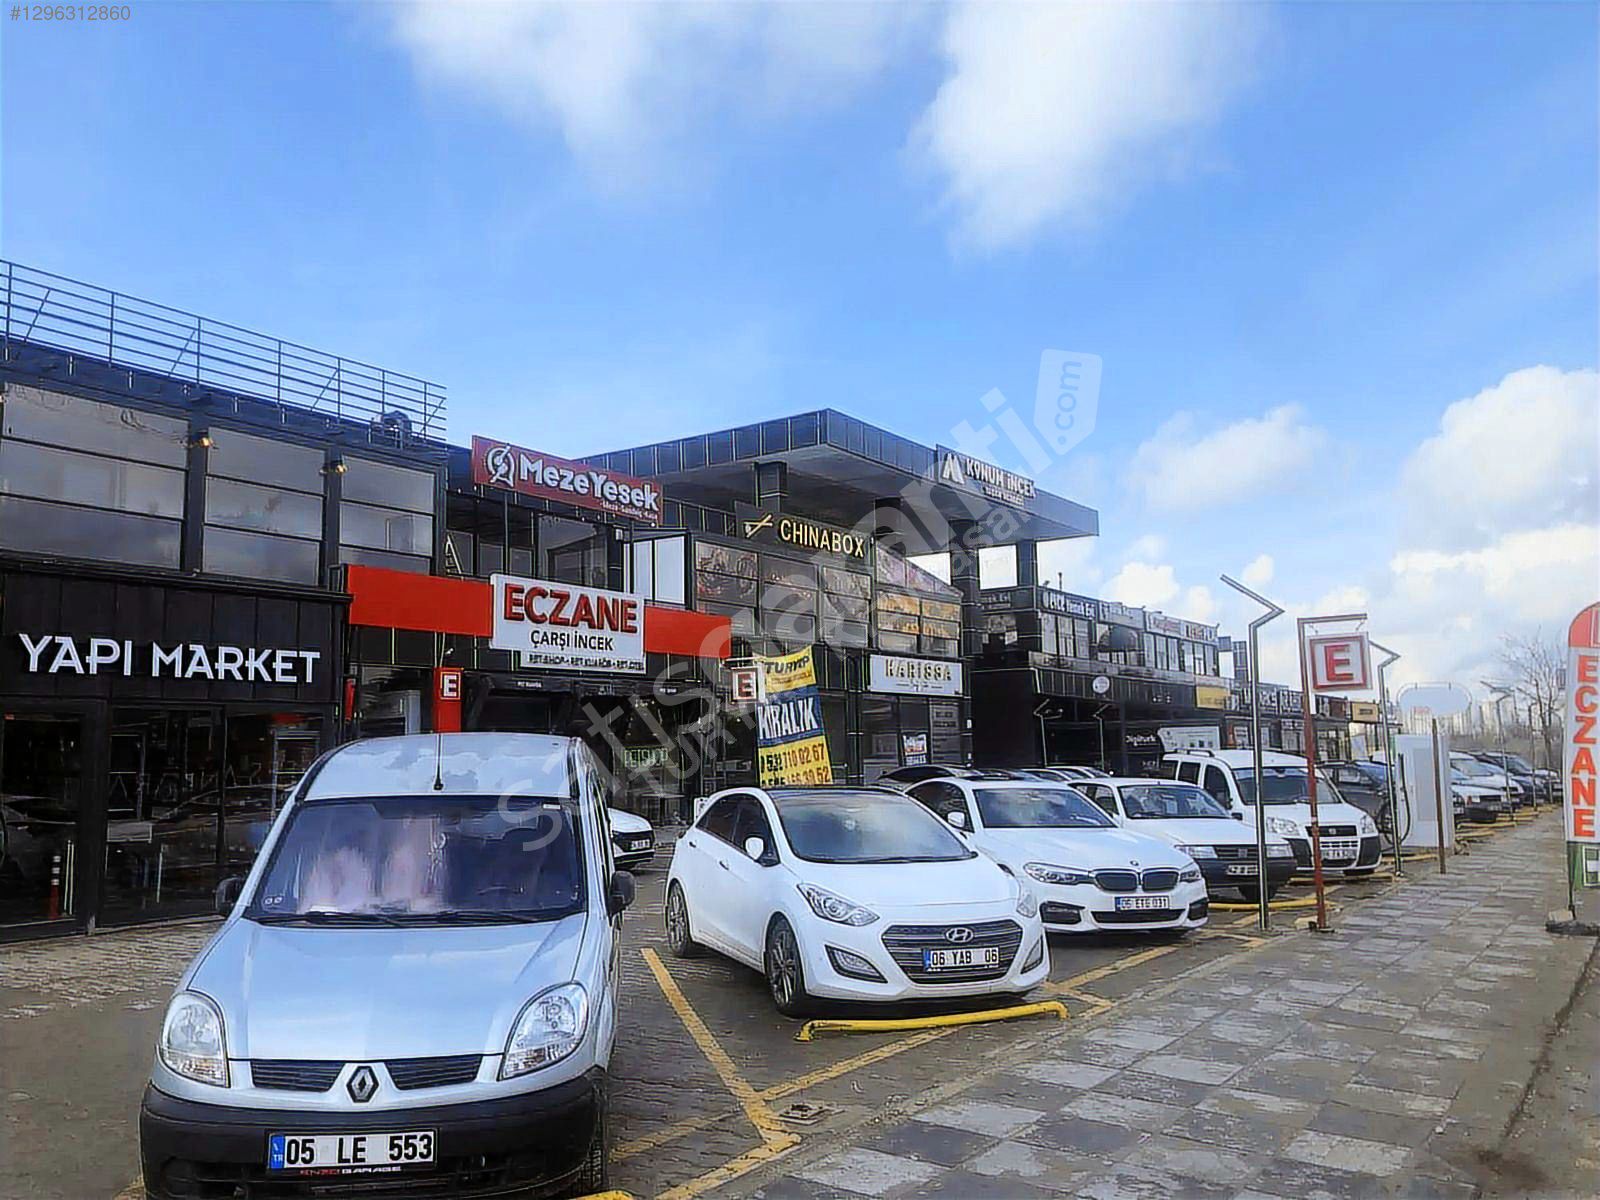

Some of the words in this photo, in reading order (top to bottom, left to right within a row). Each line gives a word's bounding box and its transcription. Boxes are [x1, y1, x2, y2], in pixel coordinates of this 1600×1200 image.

[520, 453, 659, 511] MezeYesek
[780, 519, 864, 558] CHINABOX
[504, 583, 638, 633] ECZANE
[19, 633, 132, 676] YAPI
[152, 641, 320, 683] MARKET
[531, 630, 570, 650] ÇARŞI
[574, 630, 614, 651] İNCEK
[1324, 644, 1354, 681] E
[444, 675, 457, 696] E
[738, 673, 752, 697] E
[757, 697, 818, 740] KIRALIK
[812, 743, 824, 761] 67
[1571, 655, 1599, 837] ECZANE
[932, 952, 946, 965] 06
[952, 951, 972, 965] YAB
[985, 950, 997, 963] 06
[286, 1138, 315, 1164] 05
[337, 1137, 367, 1164] LE
[389, 1134, 432, 1161] 553
